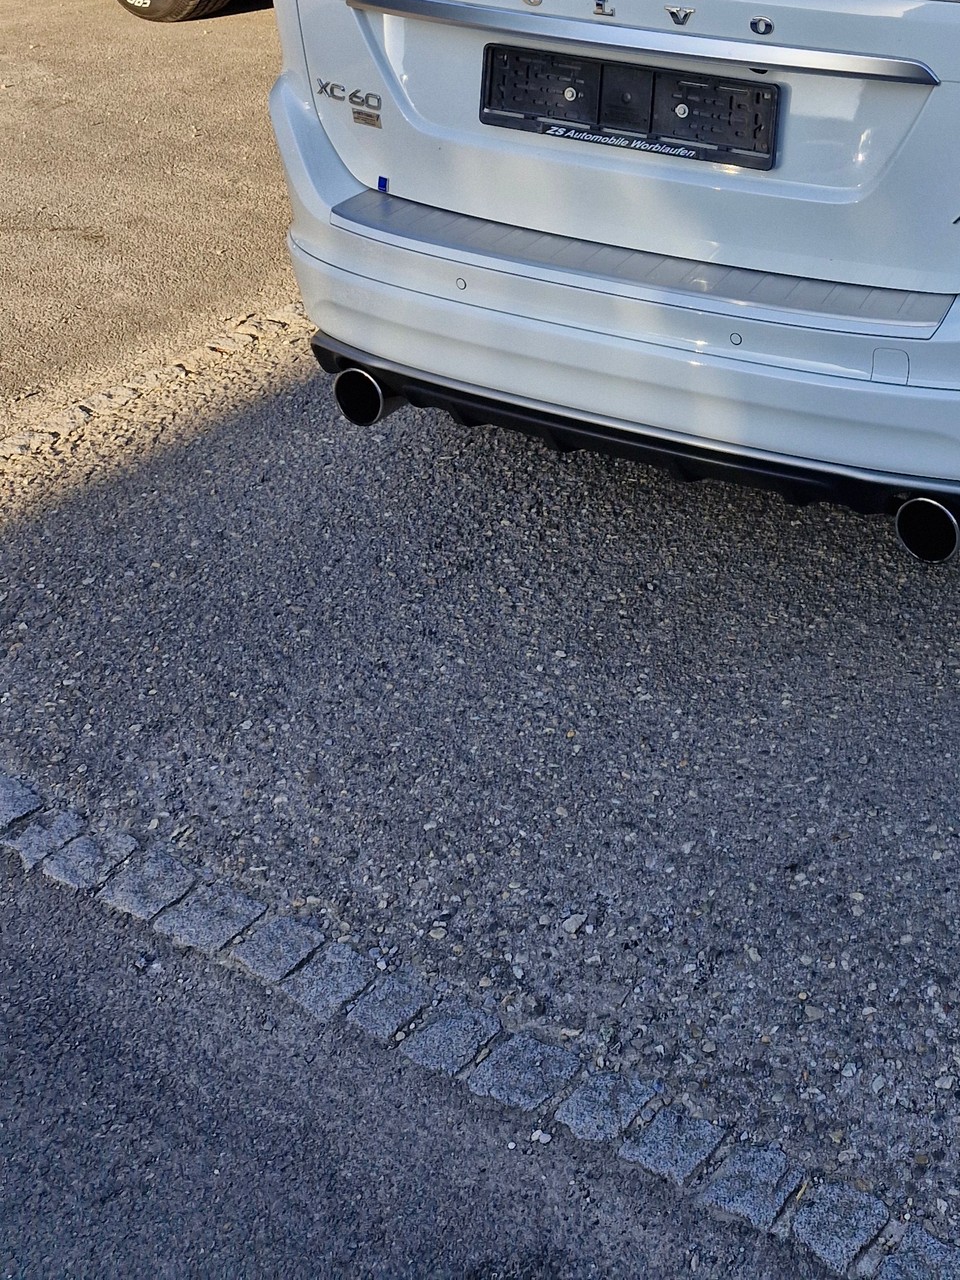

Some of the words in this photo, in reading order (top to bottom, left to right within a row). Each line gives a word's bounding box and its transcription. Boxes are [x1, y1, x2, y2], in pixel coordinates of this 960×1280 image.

[546, 126, 565, 136] ZS
[565, 129, 629, 147] Automobile
[631, 139, 696, 158] Worblaufen
